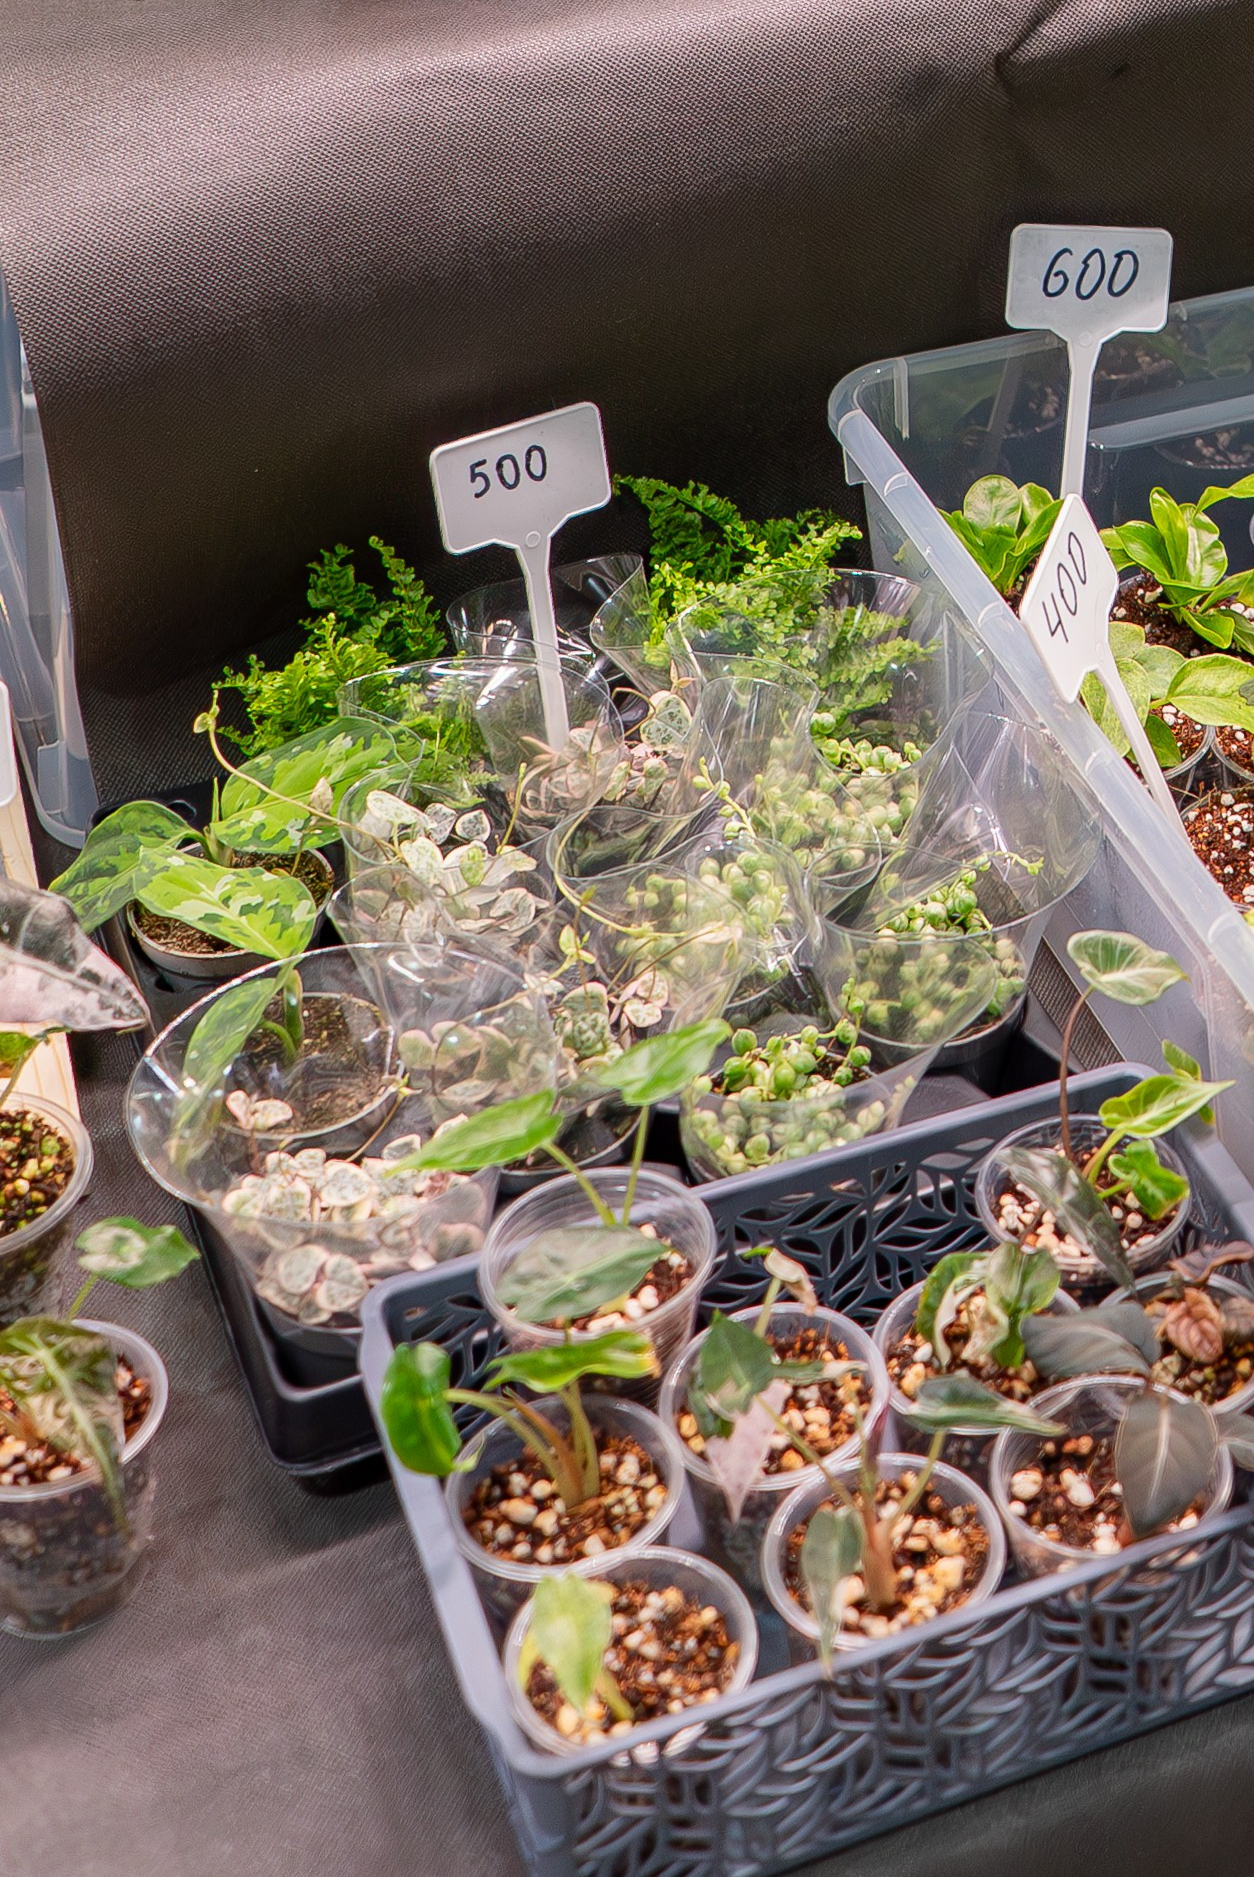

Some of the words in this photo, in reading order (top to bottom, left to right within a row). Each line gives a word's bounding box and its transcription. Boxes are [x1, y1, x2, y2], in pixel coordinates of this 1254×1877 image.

[1042, 247, 1139, 301] 600
[469, 444, 547, 498] 500
[1042, 531, 1087, 643] 400
